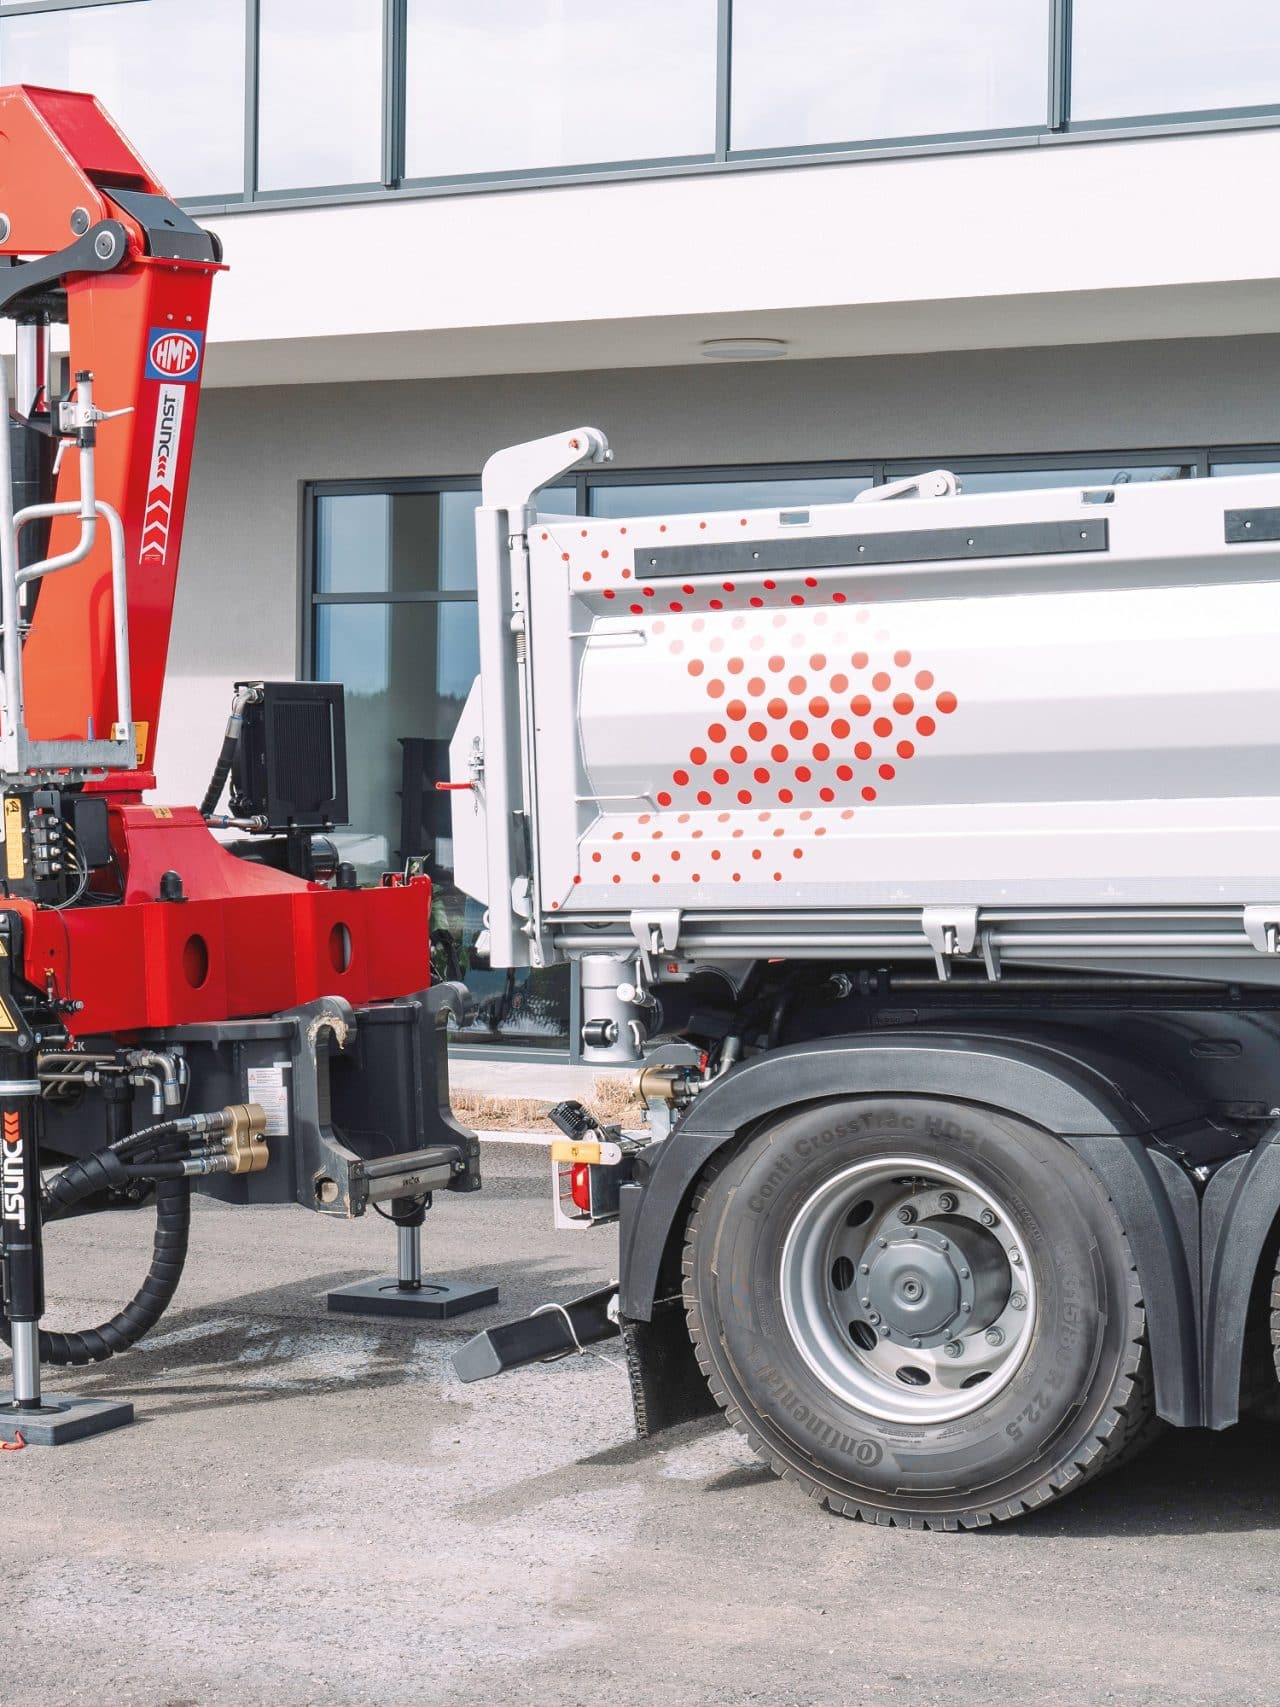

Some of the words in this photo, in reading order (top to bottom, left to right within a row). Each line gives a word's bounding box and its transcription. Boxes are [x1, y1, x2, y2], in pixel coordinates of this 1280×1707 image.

[156, 338, 193, 371] HMF
[157, 394, 177, 458] DUNST
[3, 1139, 26, 1220] DUNST
[749, 1153, 796, 1214] Conti
[794, 1111, 915, 1159] CrossTrac
[1005, 1391, 1052, 1443] 22.5
